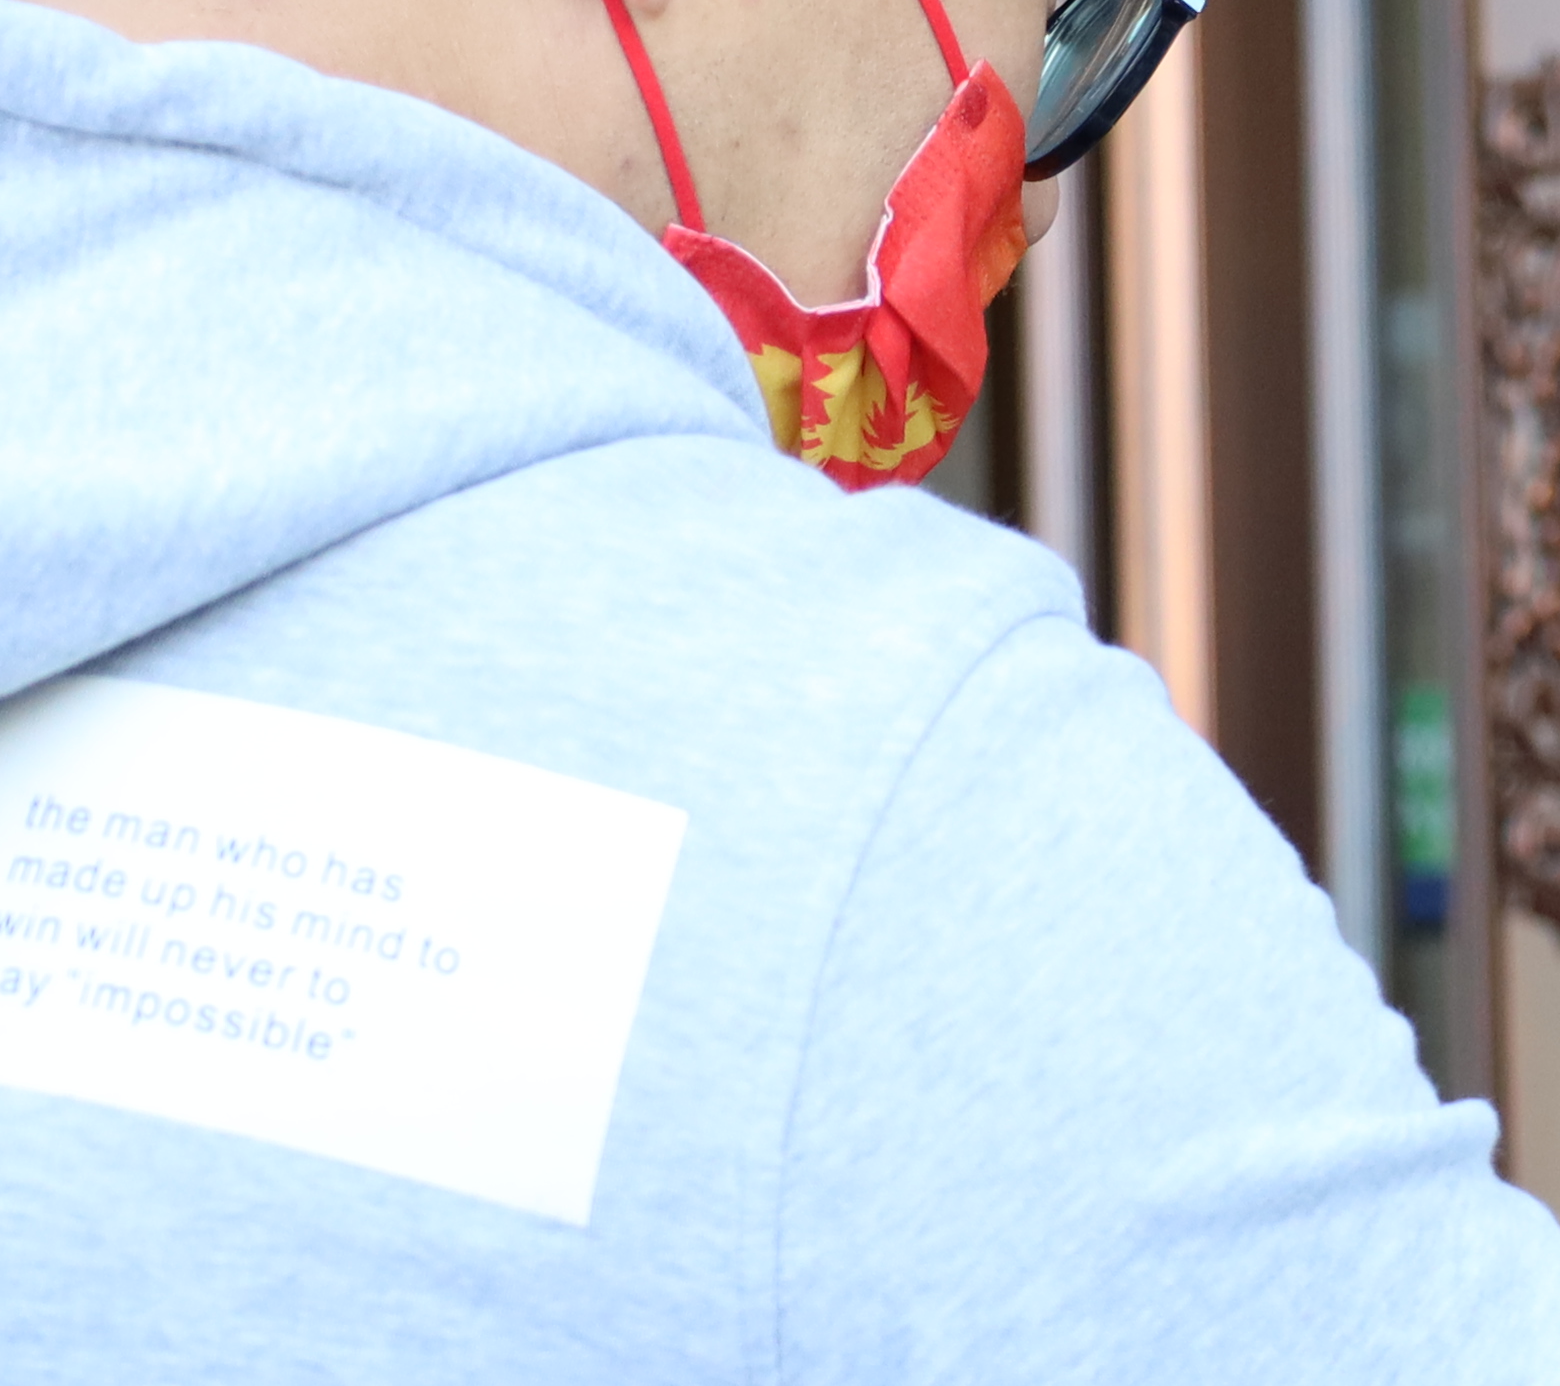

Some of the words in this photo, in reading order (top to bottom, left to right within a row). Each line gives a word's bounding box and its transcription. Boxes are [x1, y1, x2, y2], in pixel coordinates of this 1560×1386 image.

[24, 794, 92, 837] the
[102, 811, 200, 853] man
[215, 836, 308, 879] who
[321, 852, 403, 903] has
[6, 854, 128, 899] made
[140, 881, 197, 917] up
[209, 884, 277, 931] his
[291, 910, 406, 962] mind
[418, 936, 460, 976] to
[76, 923, 150, 958] will
[160, 939, 296, 989] never
[307, 967, 351, 1007] to
